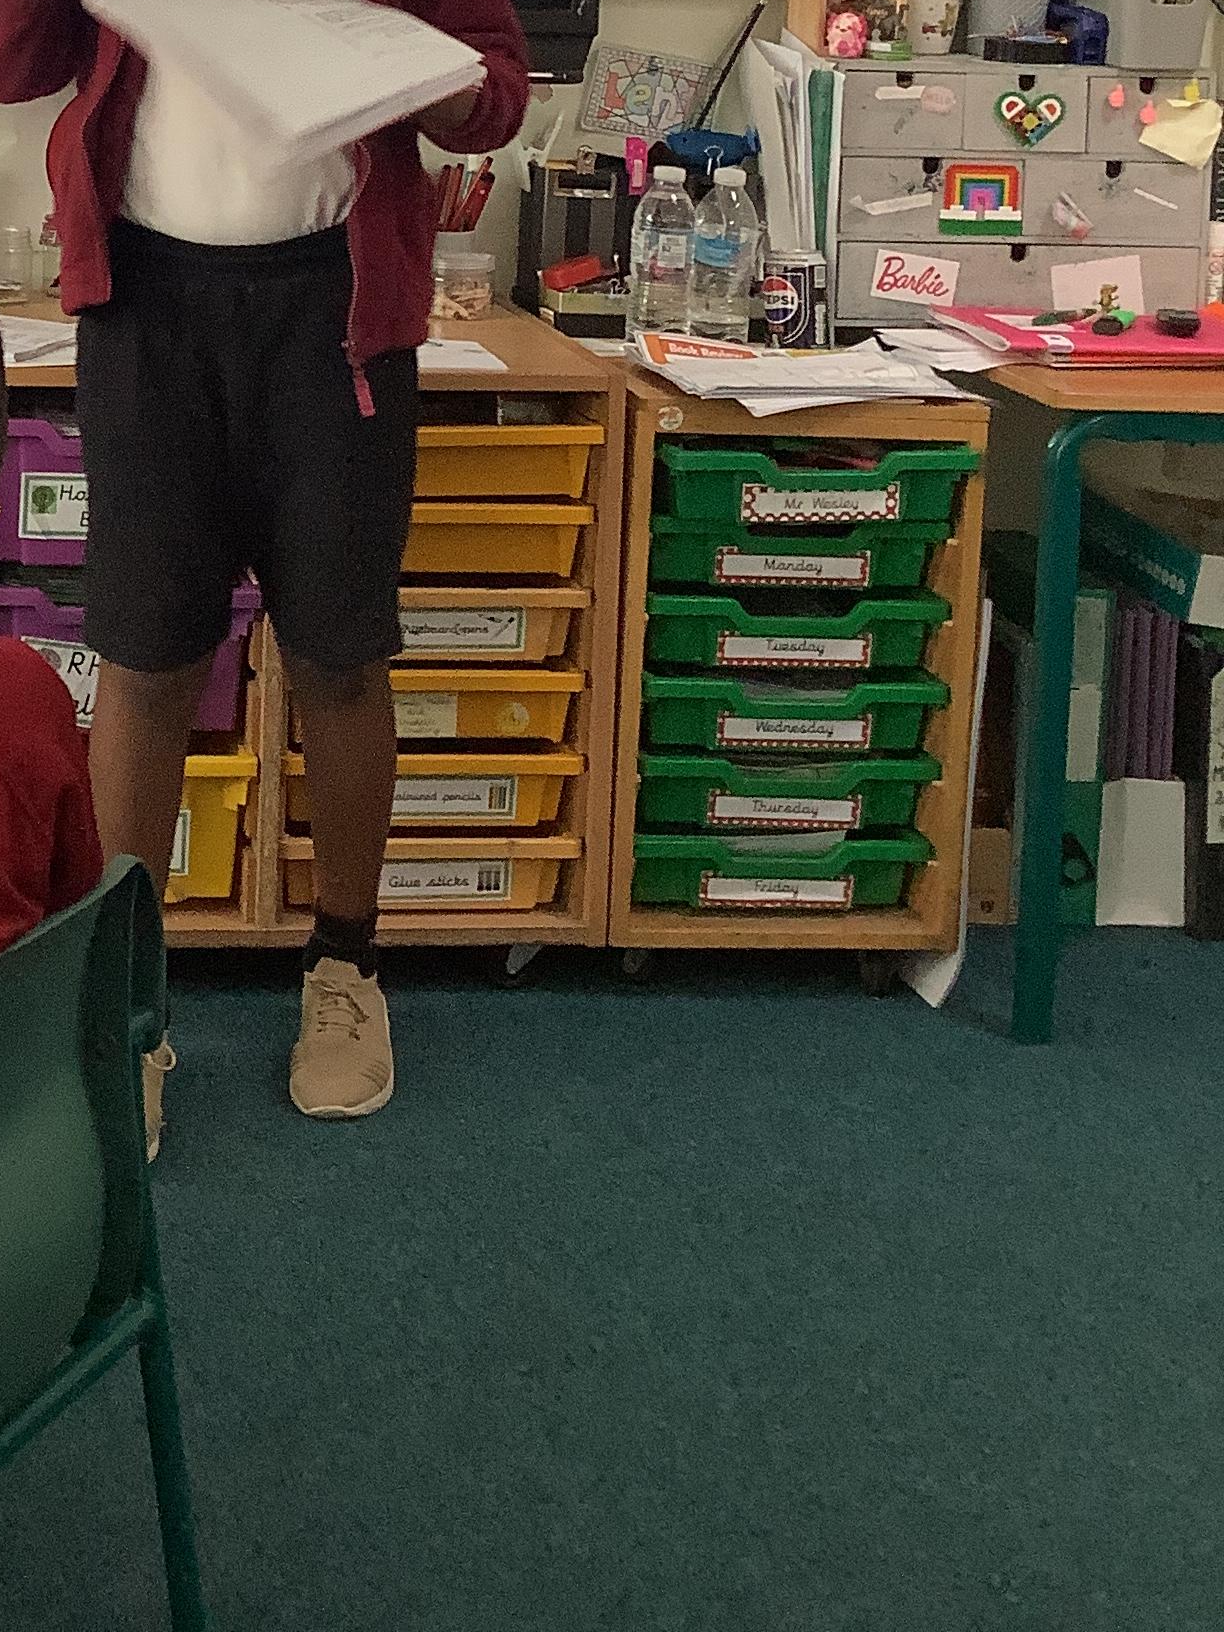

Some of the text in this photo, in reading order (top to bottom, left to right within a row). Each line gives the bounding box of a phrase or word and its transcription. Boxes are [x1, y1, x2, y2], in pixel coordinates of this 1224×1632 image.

[877, 256, 950, 297] Barbie
[669, 343, 699, 356] Book
[785, 497, 859, 512] Mr Wesley
[764, 559, 823, 575] Monday
[765, 639, 825, 656] Tuesday
[755, 721, 834, 737] Wednesday
[442, 792, 481, 803] pencils
[752, 800, 819, 817] Thursday
[389, 874, 469, 888] Glue sticks
[754, 880, 798, 898] Friday
